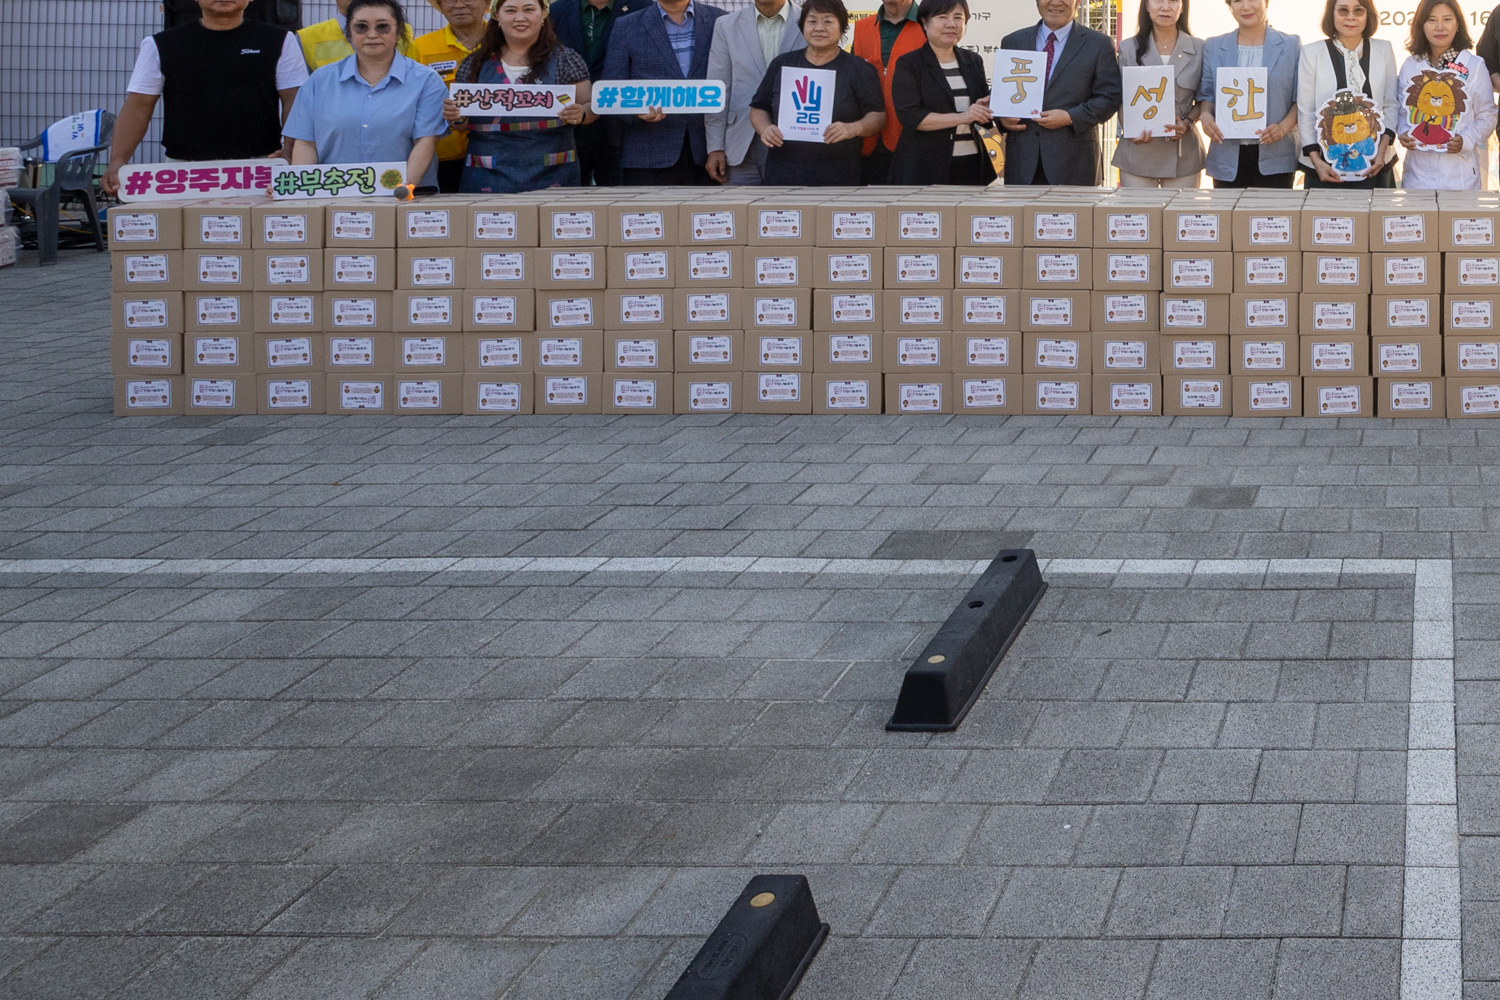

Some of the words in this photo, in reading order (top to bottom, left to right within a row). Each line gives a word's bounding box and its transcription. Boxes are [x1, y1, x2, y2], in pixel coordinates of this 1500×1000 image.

[1379, 11, 1415, 26] 202
[1001, 57, 1039, 104] 풍
[453, 88, 553, 111] #산적꼬치
[597, 85, 722, 109] #함께해요
[1130, 76, 1168, 120] 성
[1220, 77, 1265, 122] 한
[796, 112, 820, 124] 26
[274, 166, 377, 196] #부추전
